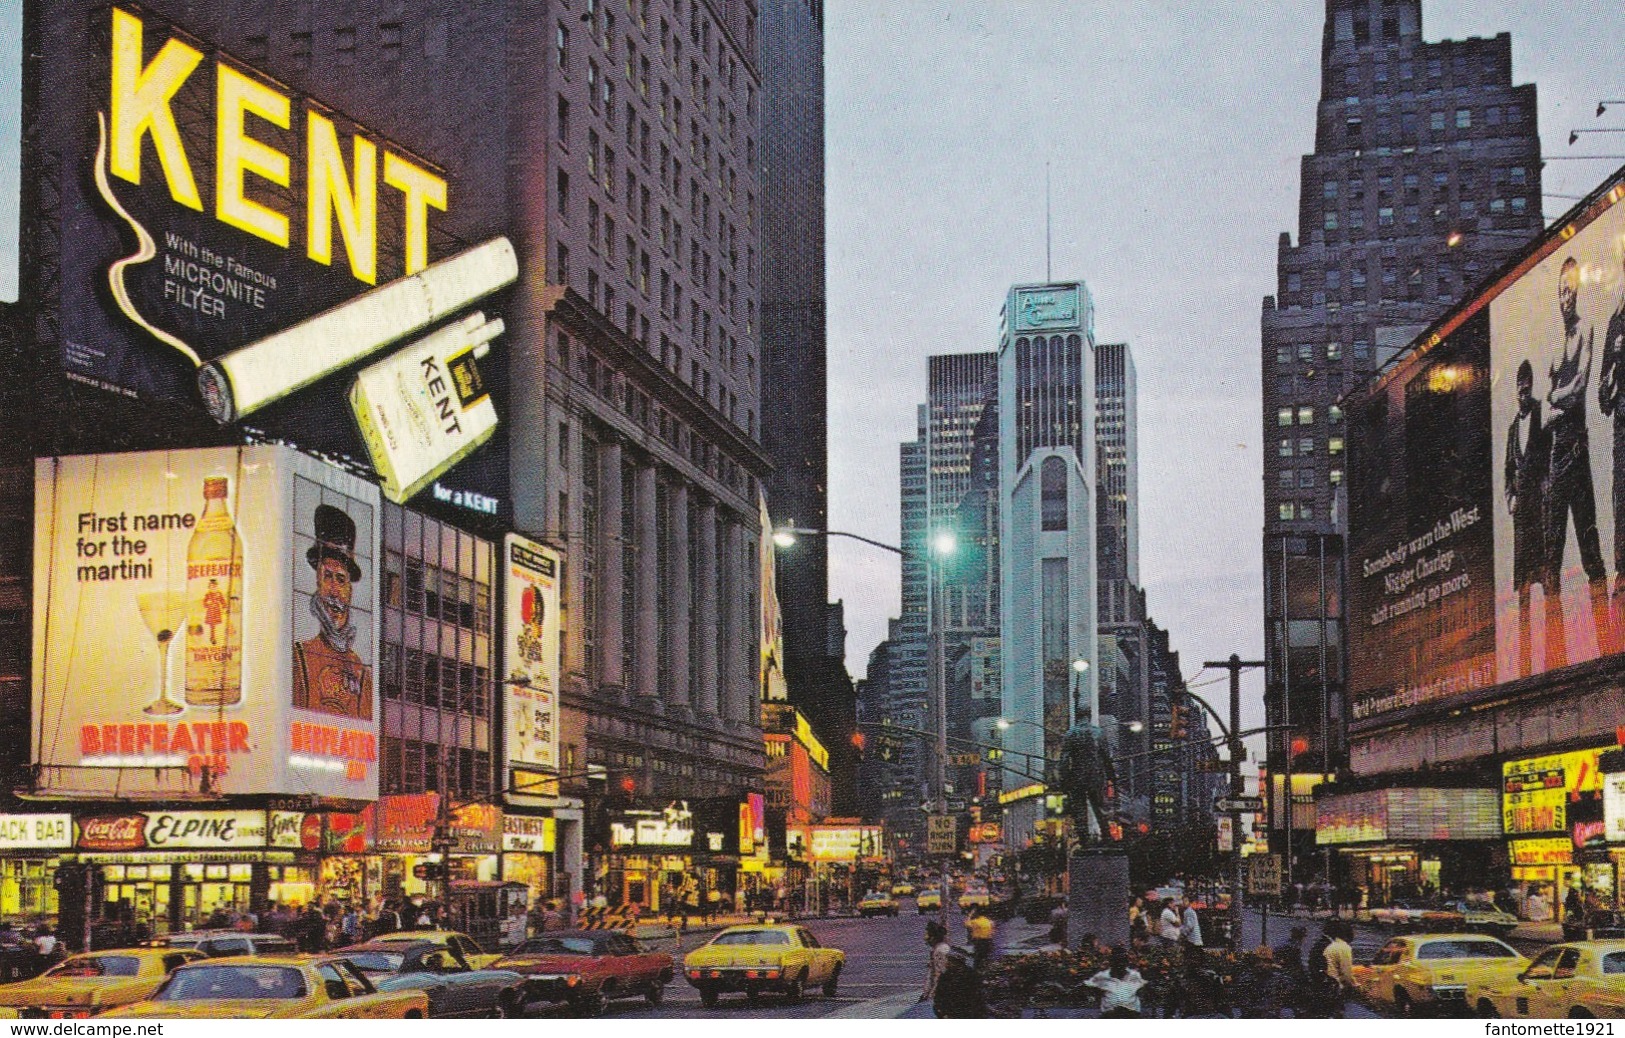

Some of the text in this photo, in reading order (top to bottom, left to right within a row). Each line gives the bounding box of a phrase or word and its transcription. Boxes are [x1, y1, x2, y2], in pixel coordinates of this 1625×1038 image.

[111, 6, 447, 286] KENT
[165, 231, 277, 290] With the Famous
[165, 254, 265, 309] MICRONITE
[165, 280, 225, 319] FILTER
[421, 356, 462, 434] KENT
[454, 490, 462, 505] a
[464, 490, 499, 515] KENT
[78, 512, 196, 534] First name
[76, 535, 147, 557] for the
[1363, 542, 1408, 578] Somebody
[1409, 532, 1433, 555] warn
[1433, 520, 1451, 542] the
[77, 558, 153, 582] martini
[80, 720, 250, 755] BEEFEATER
[291, 722, 376, 762] BEEFEATER
[36, 820, 65, 841] BAR
[935, 819, 951, 829] NO
